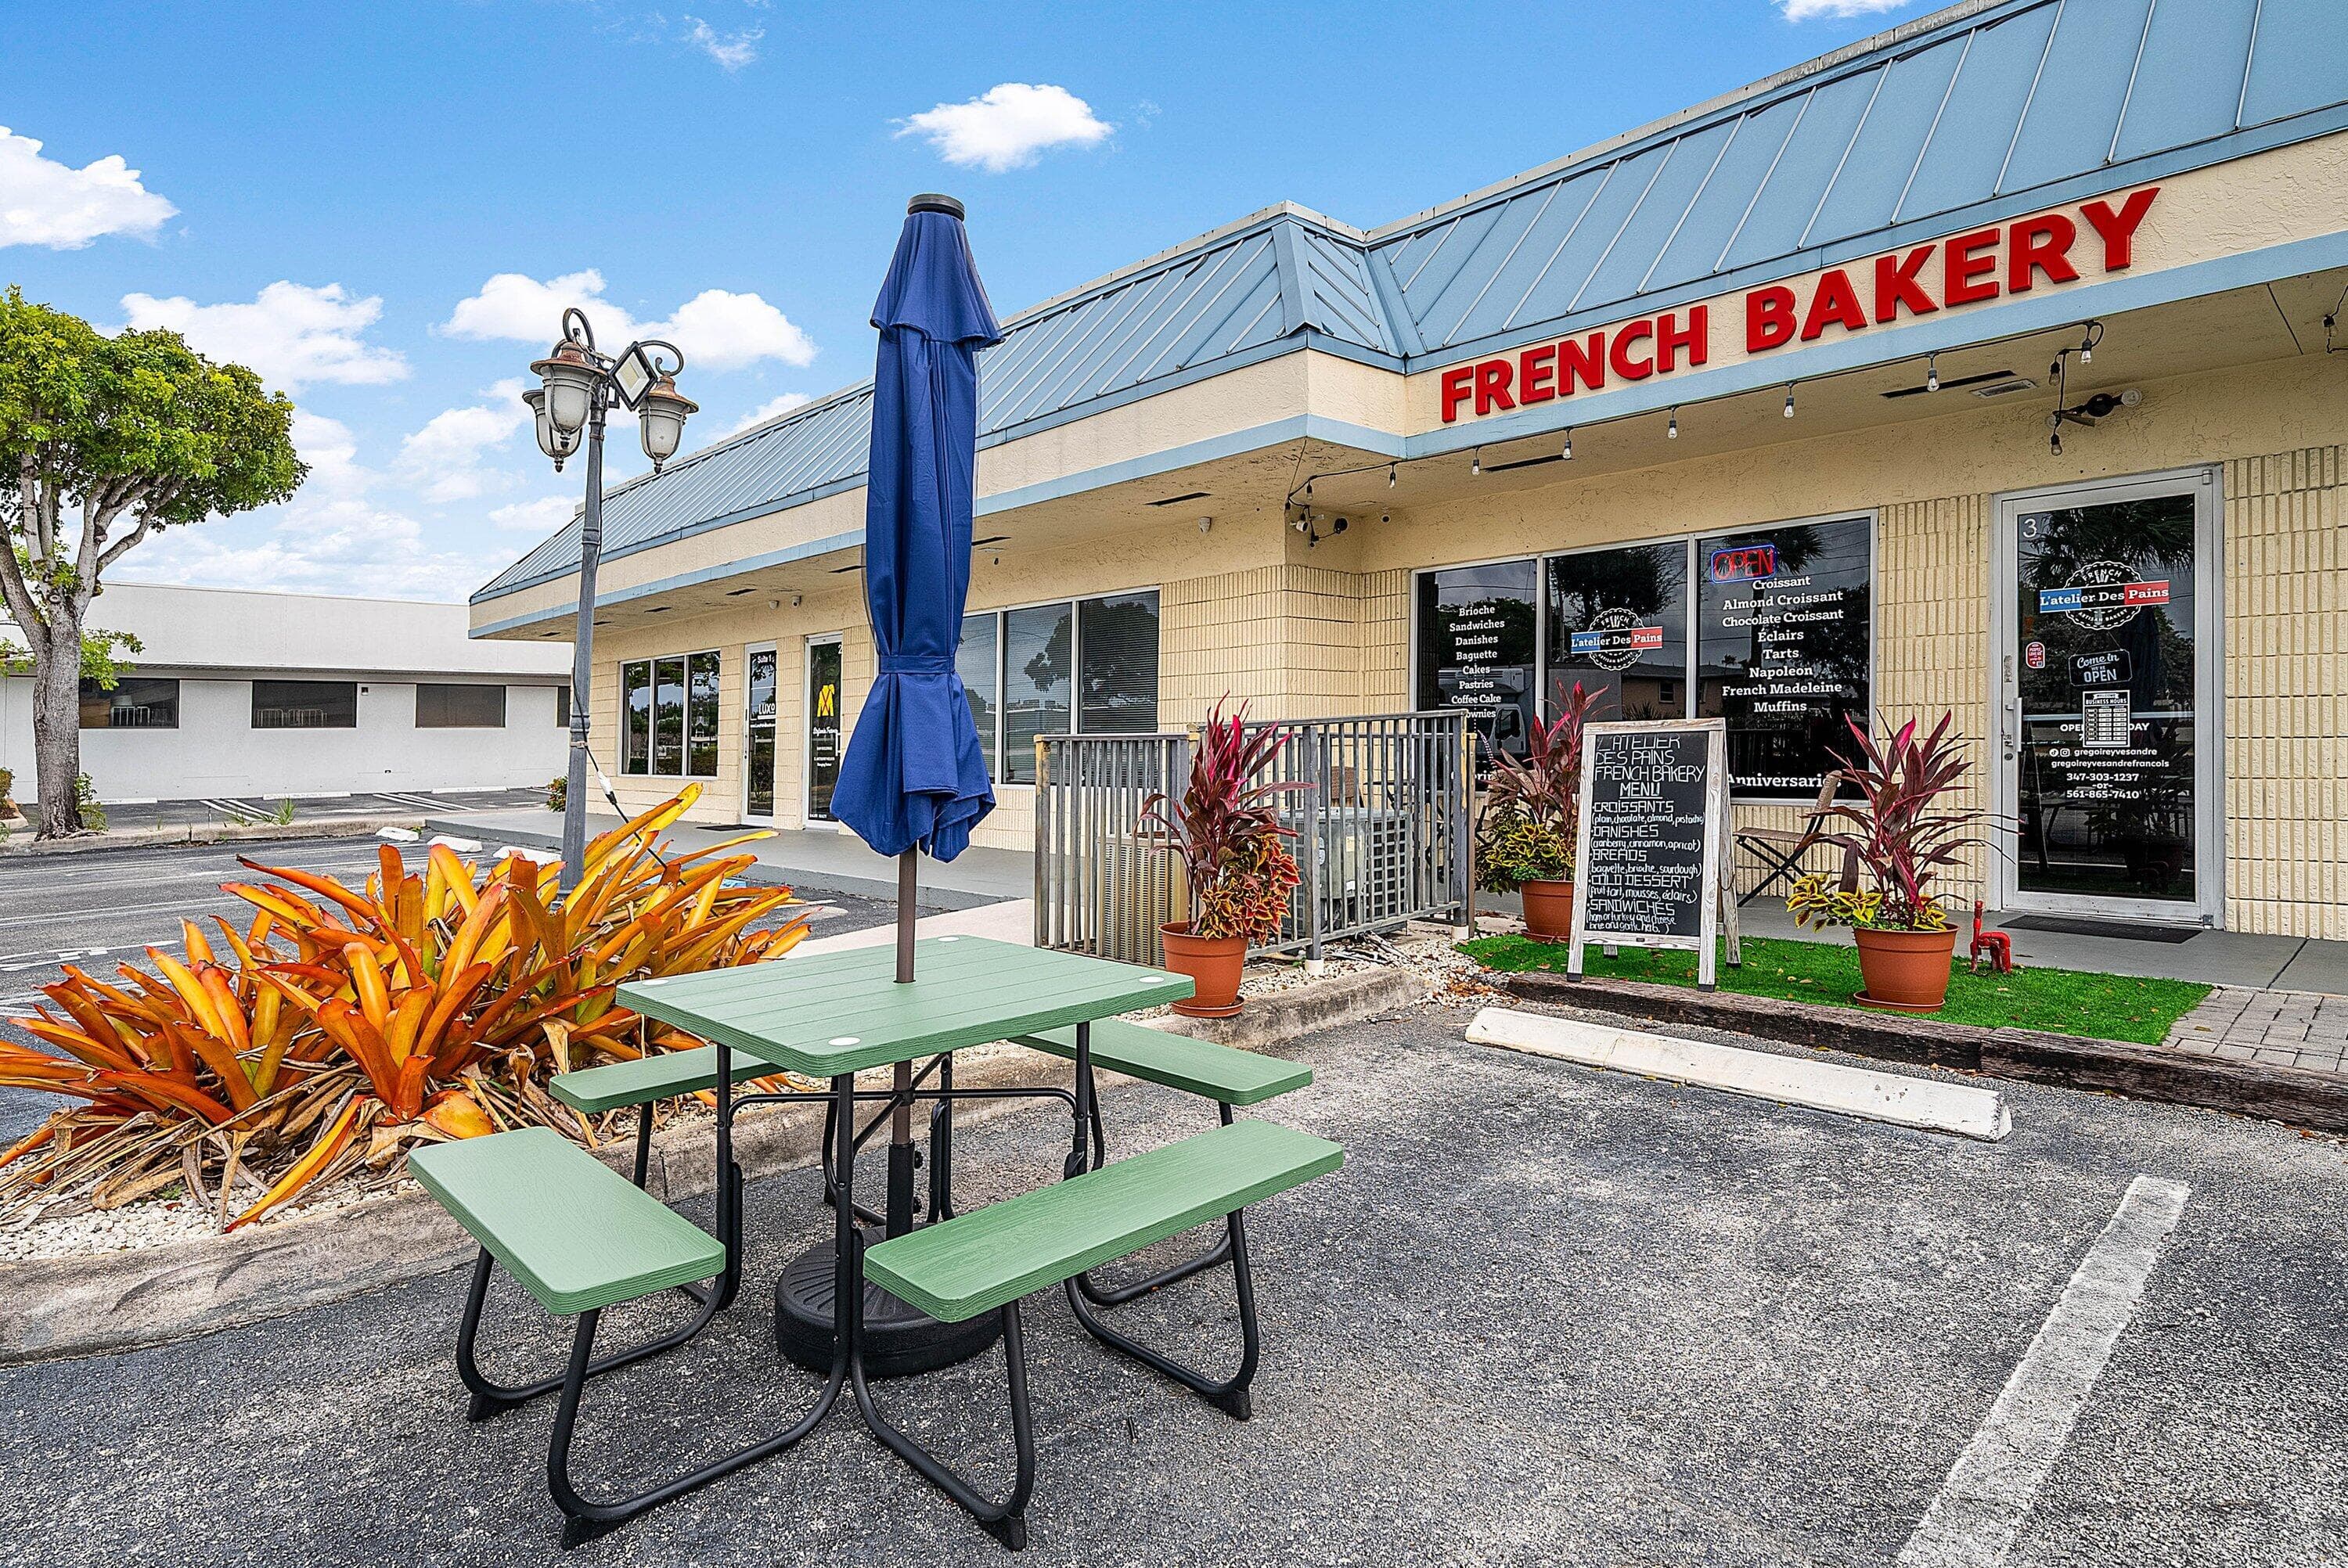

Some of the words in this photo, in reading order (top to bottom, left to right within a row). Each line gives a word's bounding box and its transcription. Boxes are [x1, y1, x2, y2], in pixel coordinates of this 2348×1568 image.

[1442, 304, 1709, 423] FRENCH
[1745, 186, 2162, 354] BAKERY
[2022, 518, 2037, 538] 3
[1713, 547, 1775, 580] OPEN
[2082, 569, 2122, 581] FRENCH
[1752, 575, 1810, 590] Croissant
[1723, 596, 1774, 610] Almond
[1777, 591, 1843, 605] Croissant
[2040, 592, 2096, 606] L'atelier
[2098, 592, 2125, 602] Des
[2128, 587, 2169, 599] Pains
[1458, 605, 1496, 617] Brioche
[1723, 614, 1781, 628] Chocolate
[1783, 609, 1844, 624] Croissant
[1449, 620, 1505, 632] Sandwiches
[1455, 635, 1499, 646] Danishes
[1572, 636, 1611, 648] L'atelier
[1612, 635, 1631, 645] Des
[1633, 632, 1662, 643] Pains
[1758, 628, 1804, 642] Éclairs
[1456, 650, 1498, 662] Baguette
[1763, 649, 1799, 660] Tarts
[2076, 656, 2107, 669] Come
[2107, 653, 2119, 662] in
[1462, 665, 1491, 675] Cakes
[1749, 666, 1813, 680] Napoleon
[2083, 669, 2117, 683] OPEN
[1459, 680, 1494, 690] Pastries
[1722, 685, 1766, 696] French
[1770, 682, 1842, 695] Madeleine
[1451, 695, 1478, 704] Coffee
[1479, 693, 1501, 703] Cake
[1466, 708, 1496, 718] ownies
[1754, 700, 1807, 713] Muffins
[2060, 724, 2083, 732] OPE
[1595, 750, 1628, 765] DES
[1631, 749, 1675, 765] PAINS
[1595, 765, 1649, 782] FRENCH
[1652, 764, 1705, 782] BAKERY
[1619, 782, 1660, 797] MENU
[2066, 789, 2140, 799] 561-865-7410
[1594, 800, 1674, 813] CROISSANTS
[1593, 825, 1658, 838] DANISHES
[1593, 850, 1647, 861] BREADS
[1591, 874, 1622, 886] COLD
[1625, 875, 1688, 889] DESSERT
[1590, 899, 1675, 916] SANDWICHES
